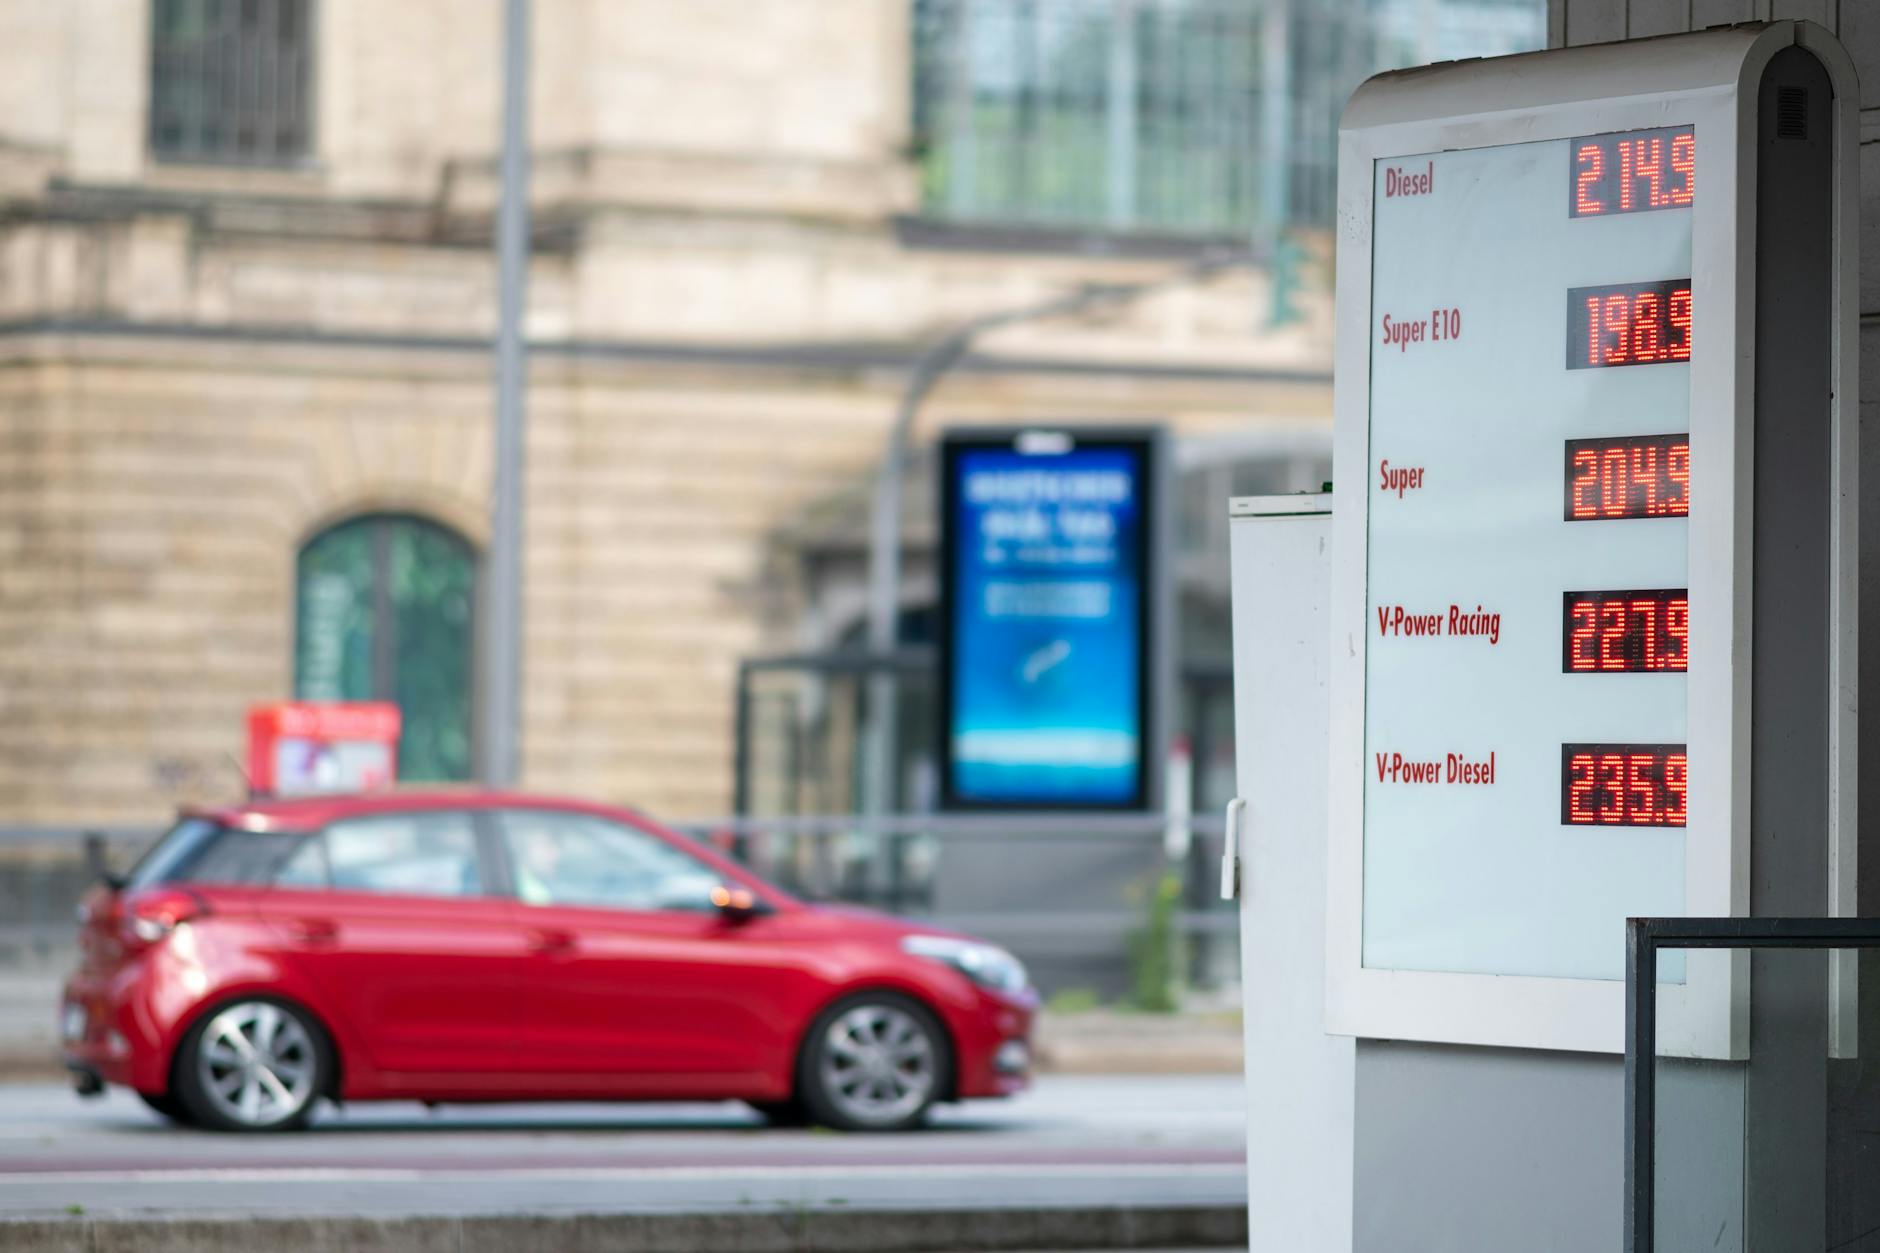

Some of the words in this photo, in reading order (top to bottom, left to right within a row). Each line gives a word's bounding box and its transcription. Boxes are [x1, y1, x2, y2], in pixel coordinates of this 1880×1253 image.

[1385, 161, 1434, 198] Diesel
[1577, 135, 1694, 214] 214.9
[1382, 312, 1428, 352] Super
[1431, 308, 1461, 341] E10
[1586, 289, 1692, 363] 198.9
[1380, 459, 1425, 498] Super
[1573, 445, 1689, 517] 204.9
[1378, 606, 1443, 637] V-Power
[1448, 604, 1501, 645] Racing
[1571, 600, 1688, 669] 227.9
[1376, 752, 1442, 784] V-Power
[1446, 751, 1496, 784] Diesel
[1571, 755, 1687, 823] 235.9
